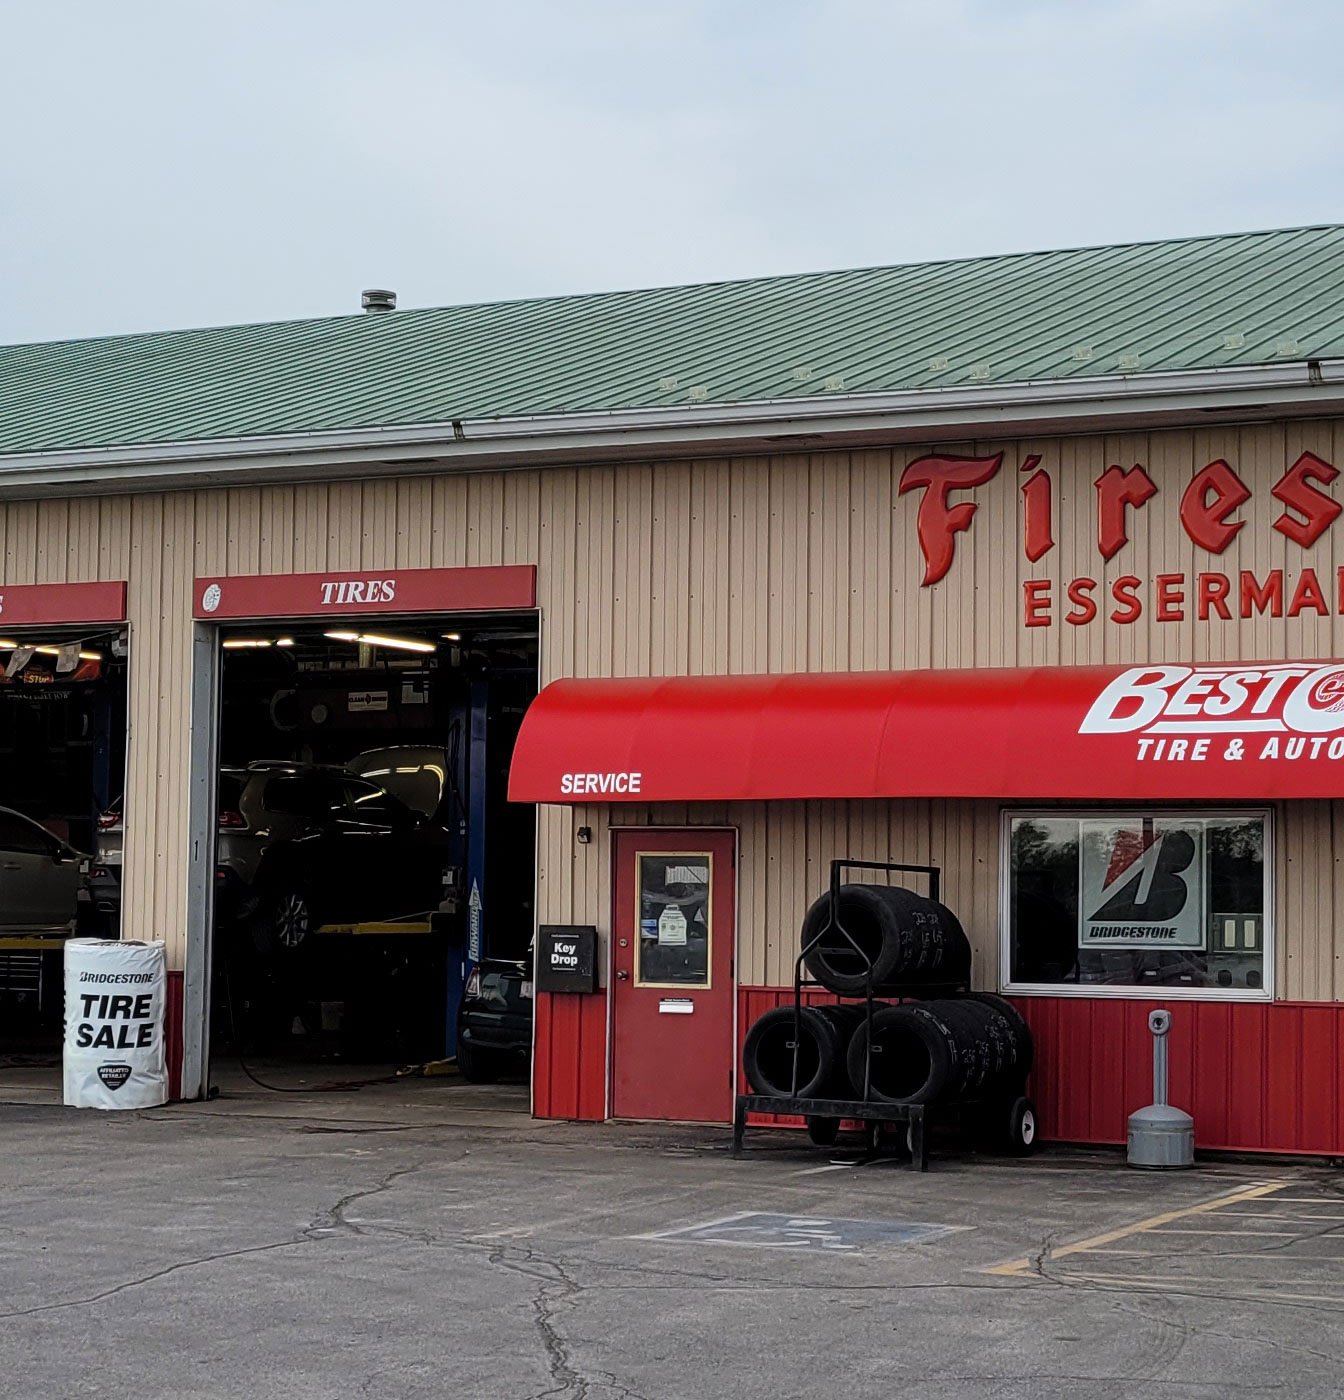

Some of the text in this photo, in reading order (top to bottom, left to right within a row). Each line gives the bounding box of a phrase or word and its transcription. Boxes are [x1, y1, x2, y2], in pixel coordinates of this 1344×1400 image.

[320, 579, 396, 605] TIRES
[1136, 737, 1211, 761] TIRE
[1223, 738, 1245, 760] &
[560, 772, 641, 794] SERVICE
[1089, 926, 1178, 939] BRIDGESTONE
[554, 943, 576, 954] Key
[551, 954, 578, 966] Drop
[80, 971, 154, 984] BRIDGESTONE
[80, 993, 153, 1020] TIRE
[76, 1022, 155, 1049] SALE
